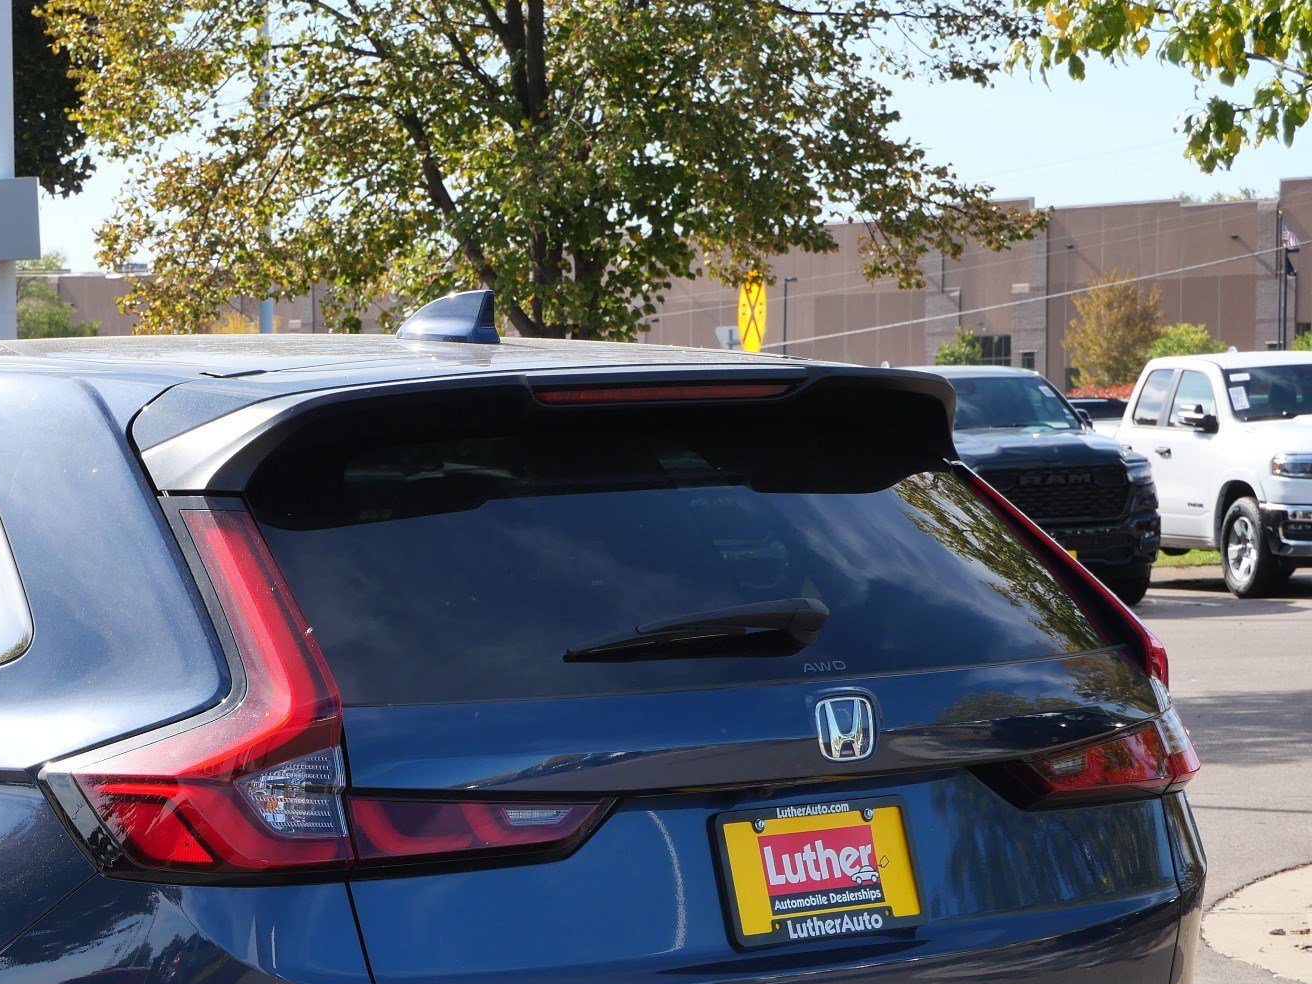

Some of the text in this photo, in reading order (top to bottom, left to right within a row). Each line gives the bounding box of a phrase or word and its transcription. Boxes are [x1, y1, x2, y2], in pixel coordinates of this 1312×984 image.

[1019, 474, 1091, 487] RAM
[803, 660, 847, 673] AWD
[776, 801, 850, 819] LutherAuto.com
[762, 839, 873, 887] Luther
[774, 887, 882, 911] Automobile Dealerships
[786, 911, 884, 939] LutherAuto
